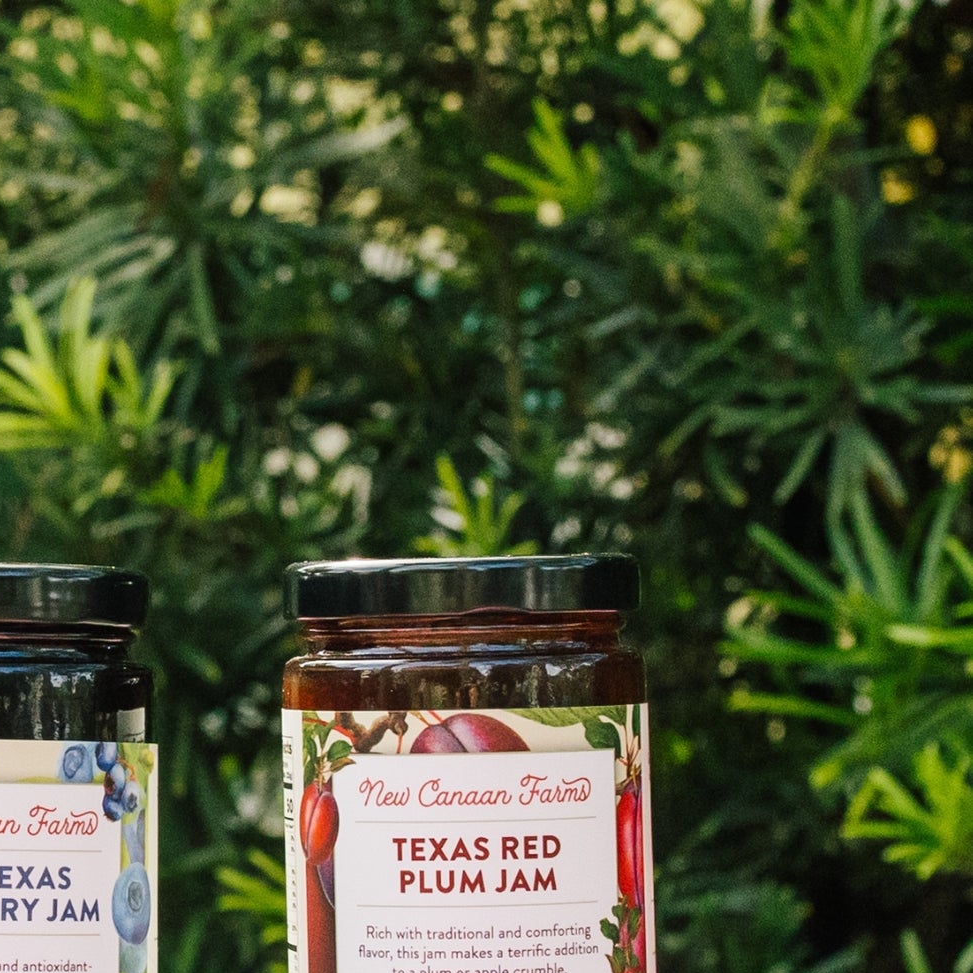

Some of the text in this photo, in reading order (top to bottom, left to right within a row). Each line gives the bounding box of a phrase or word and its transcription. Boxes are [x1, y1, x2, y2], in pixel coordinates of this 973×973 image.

[358, 773, 592, 808] New Canaan Farms
[26, 804, 99, 837] Farms
[392, 834, 562, 862] TEXAS RED
[399, 867, 557, 894] PLUM JAM
[46, 898, 100, 922] JAM
[366, 922, 592, 941] Rich with traditional and comforting
[358, 941, 599, 965] flavor, this jam makes a terrific addition
[22, 959, 93, 973] antioxidant-
